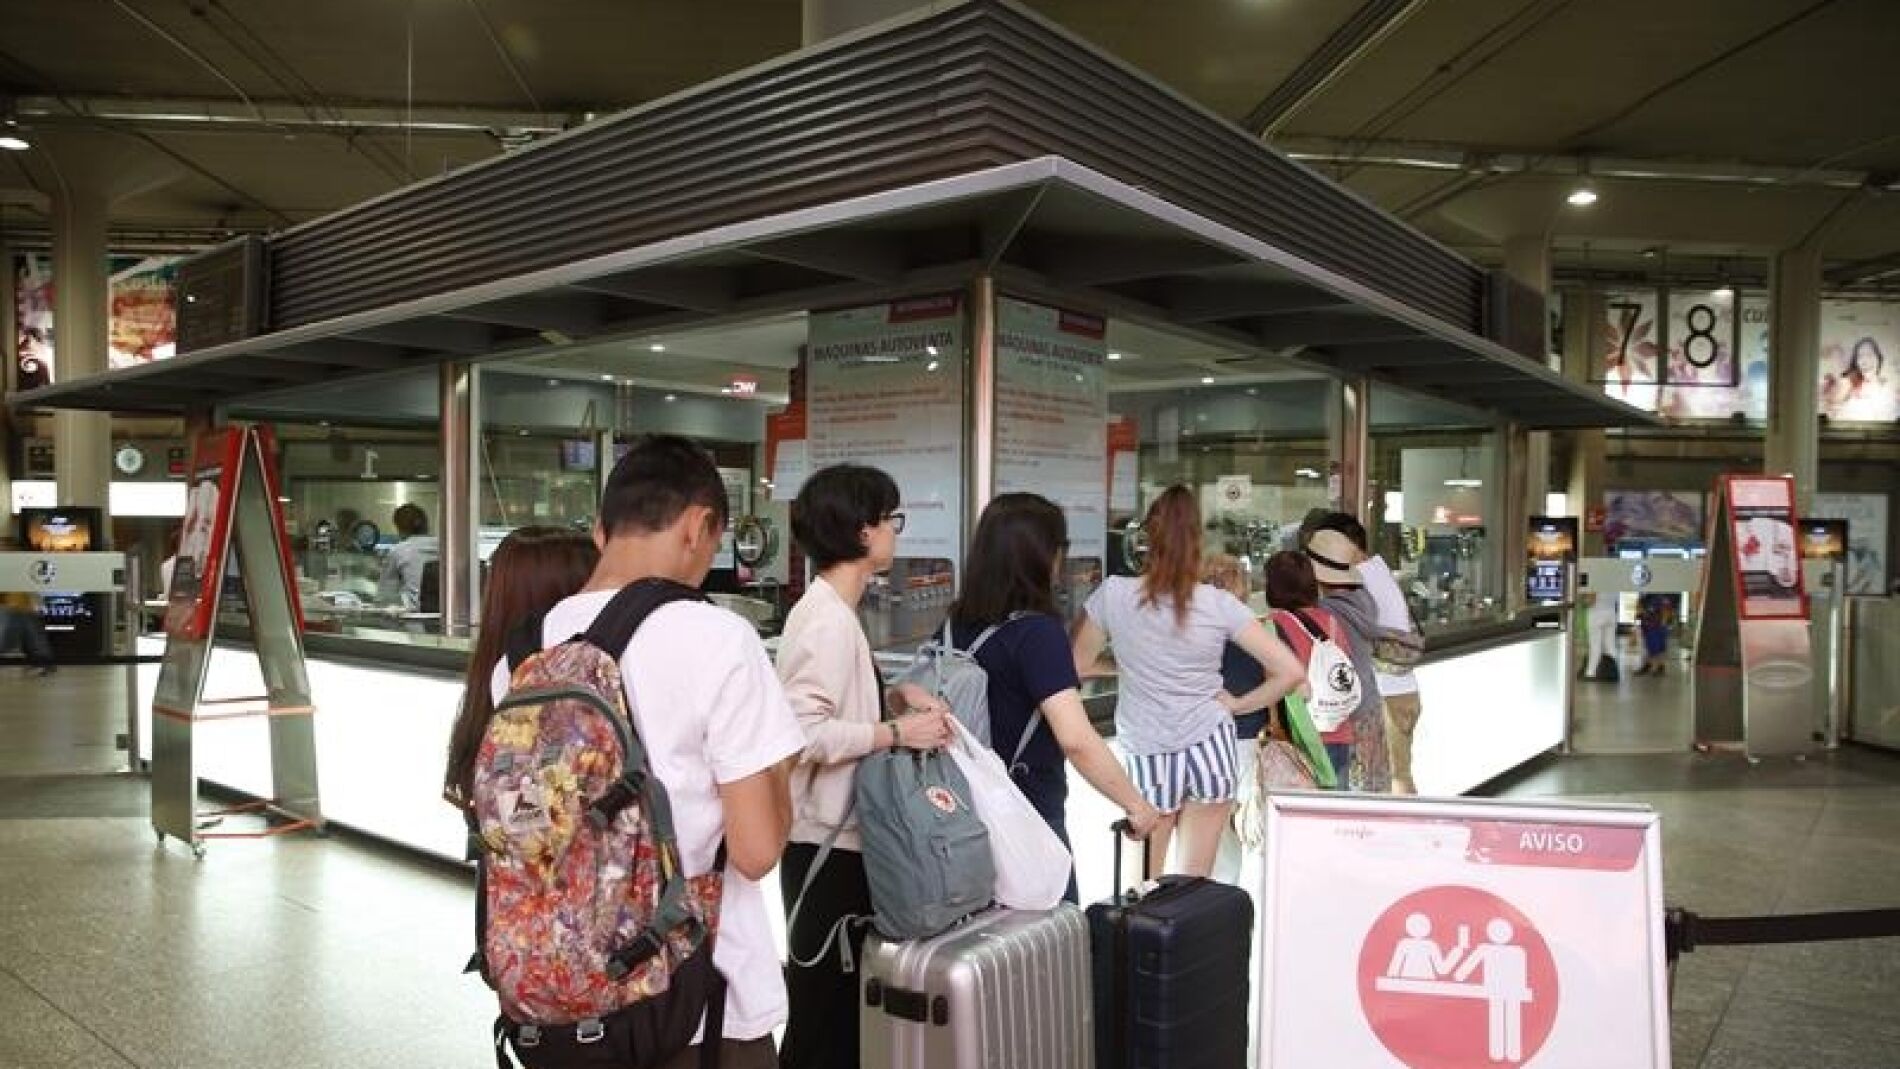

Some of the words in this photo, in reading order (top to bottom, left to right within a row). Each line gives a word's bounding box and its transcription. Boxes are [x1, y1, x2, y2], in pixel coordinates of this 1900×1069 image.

[1609, 303, 1642, 365] 7
[1683, 304, 1718, 367] 8
[1519, 830, 1584, 854] AVISO
